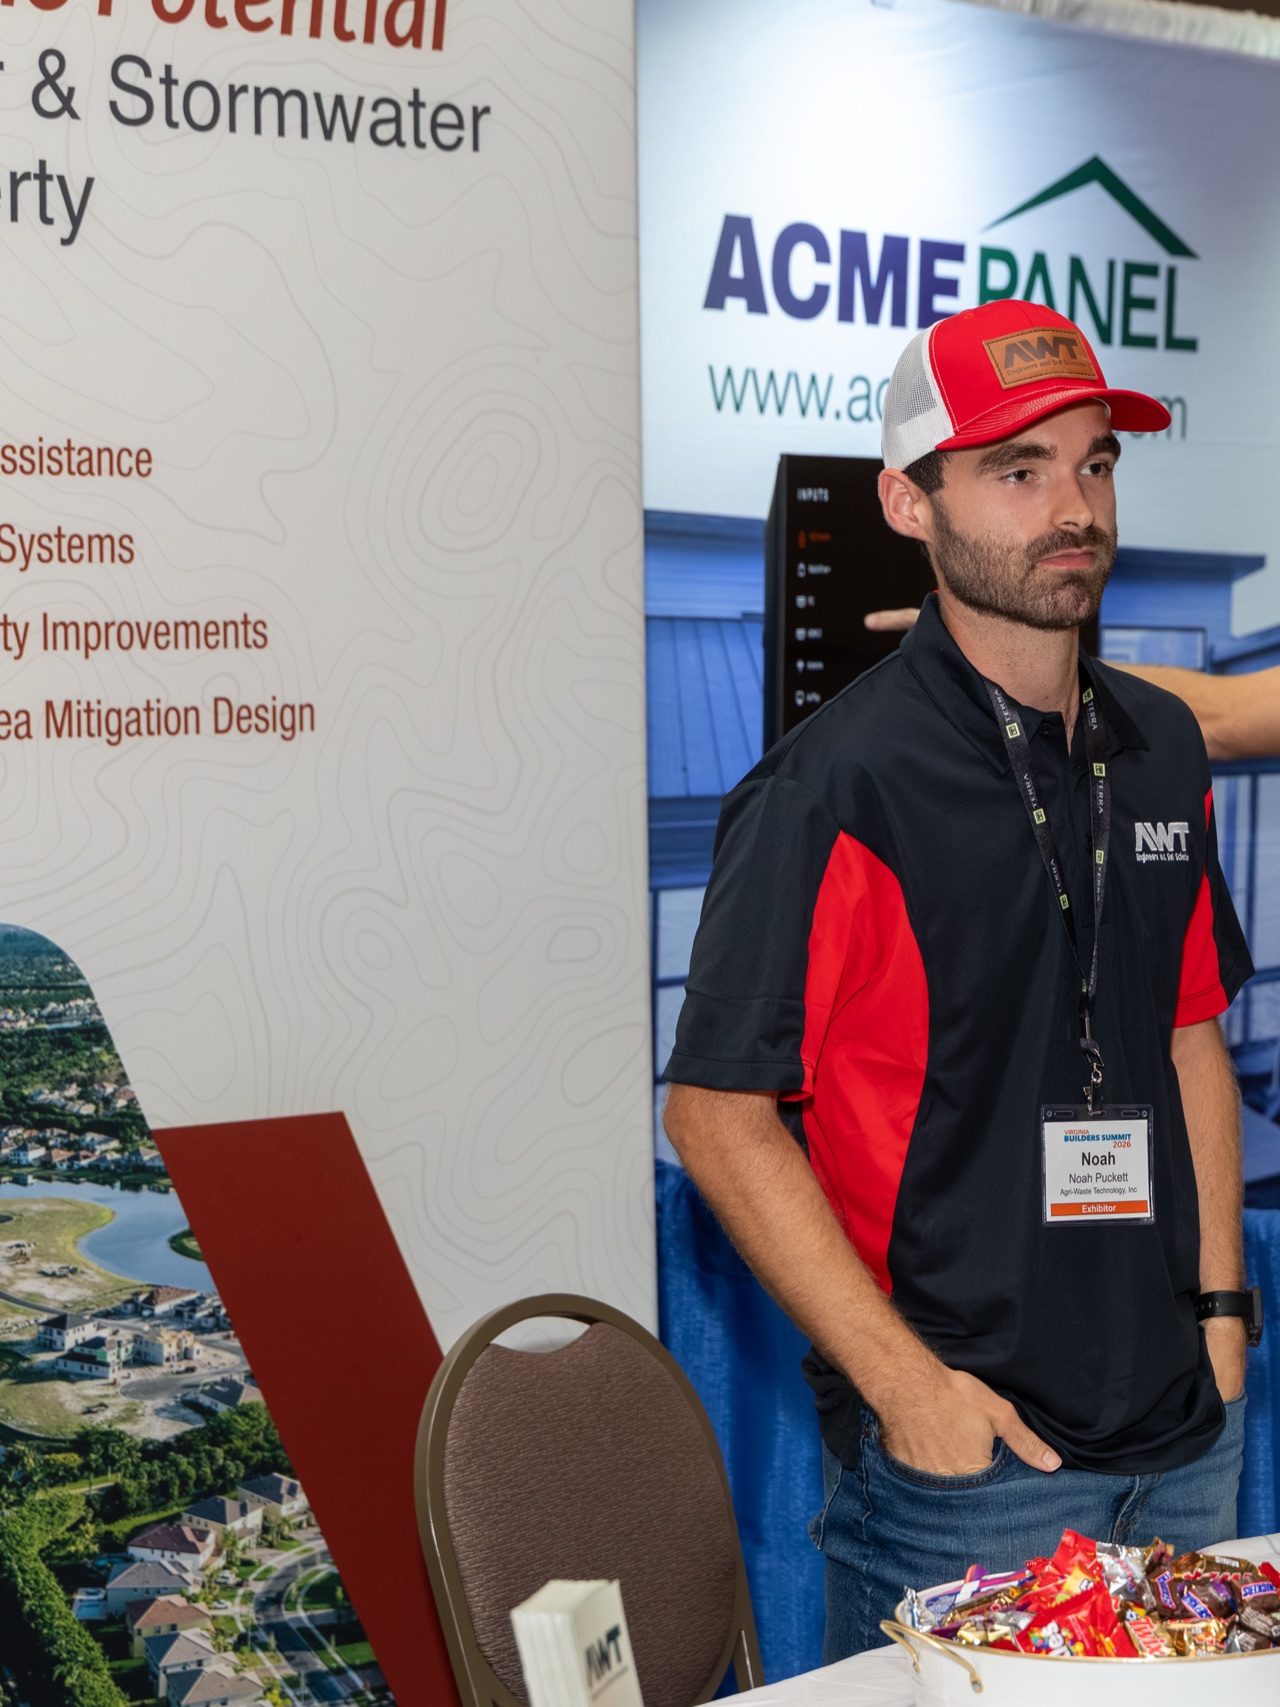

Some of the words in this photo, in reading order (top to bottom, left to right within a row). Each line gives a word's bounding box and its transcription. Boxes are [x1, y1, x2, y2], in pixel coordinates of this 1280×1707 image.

[32, 49, 81, 121] &
[109, 54, 491, 152] Stormwater
[9, 159, 95, 246] rty
[1004, 336, 1078, 369] AWT
[0, 437, 152, 478] ssistance
[797, 488, 829, 502] INPUTS
[0, 523, 135, 572] Systems
[42, 613, 268, 660] Improvements
[45, 698, 201, 746] Mitigation
[213, 696, 315, 741] Design
[994, 689, 1011, 722] TERRA
[1088, 702, 1097, 731] TERRA
[1023, 773, 1037, 808] TERRA
[1134, 822, 1189, 852] AWT
[1101, 1133, 1131, 1141] SUMMIT
[1081, 1152, 1115, 1166] Noah
[1060, 1188, 1092, 1197] Agri-Waste
[1093, 1186, 1127, 1195] Technology,
[1069, 1173, 1093, 1184] Noah
[1095, 1172, 1128, 1183] Puckett
[1081, 1204, 1116, 1213] Exhibitor
